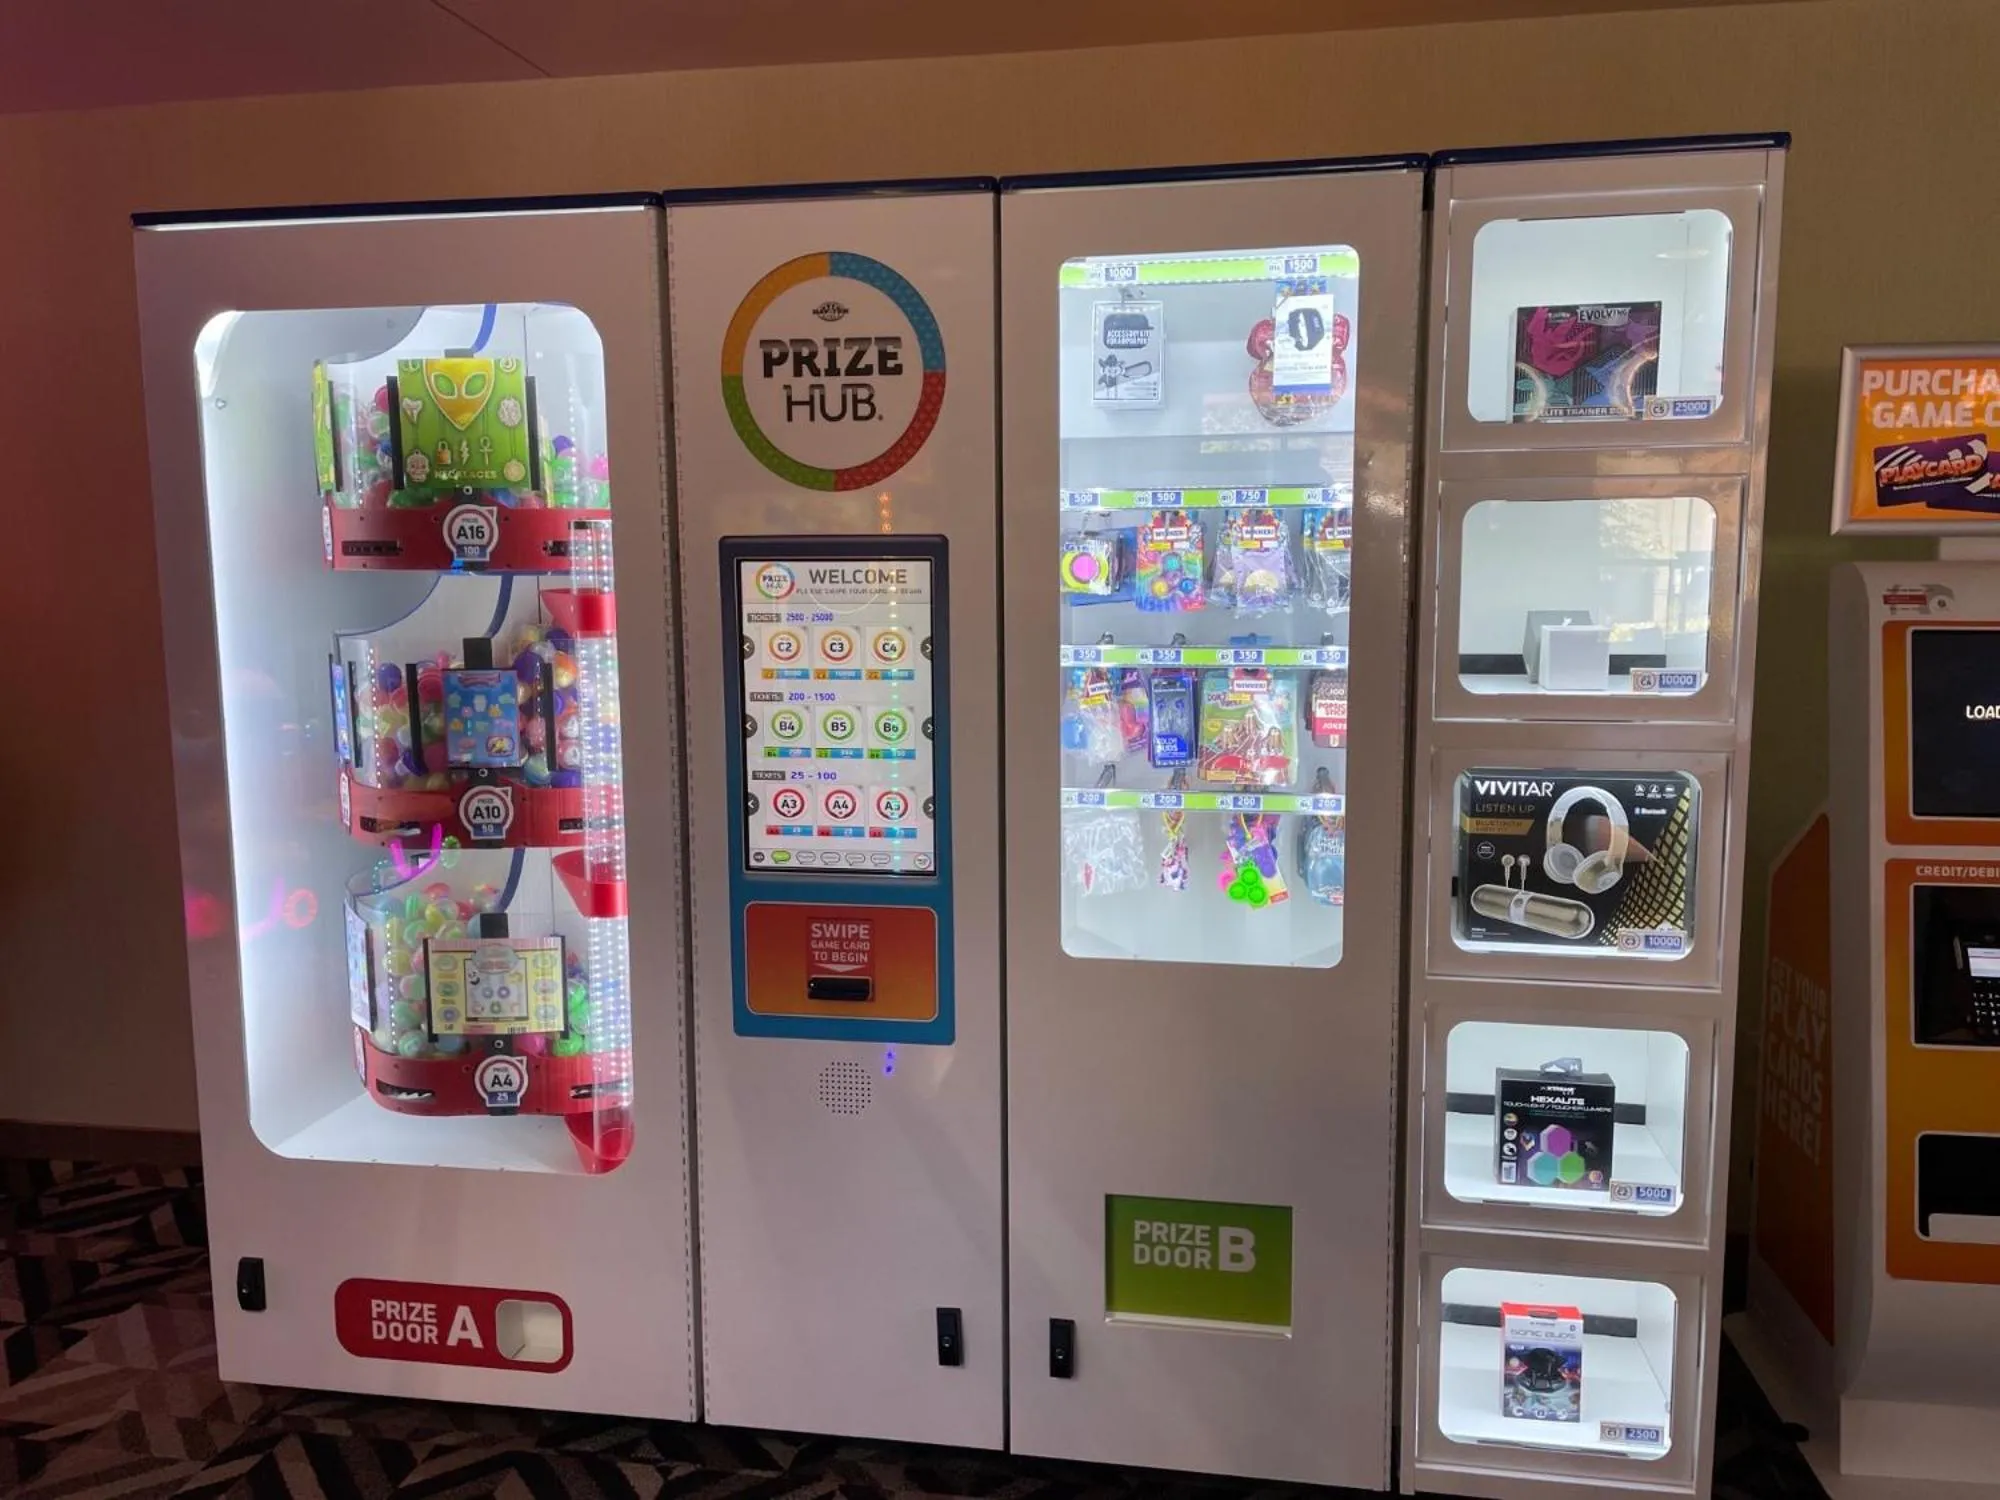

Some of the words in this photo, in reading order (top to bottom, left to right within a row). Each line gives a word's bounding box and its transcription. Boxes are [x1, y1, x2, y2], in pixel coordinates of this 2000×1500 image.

[1289, 260, 1313, 272] 1500
[1109, 268, 1133, 278] 1000
[1579, 309, 1628, 322] EVOLVING
[759, 336, 903, 378] PRIZE
[1862, 369, 2000, 396] PURCHA
[783, 383, 877, 422] HUB
[1675, 402, 1708, 411] 25000
[1540, 408, 1564, 416] ELITE
[1566, 408, 1607, 416] TRAINER
[1653, 406, 1664, 415] C5
[1873, 401, 1974, 428] GAME
[1880, 455, 1984, 484] PLAYCARD
[1074, 493, 1092, 502] 500
[1156, 491, 1176, 501] 500
[1241, 490, 1260, 500] 750
[456, 525, 485, 540] A16
[463, 545, 480, 555] 100
[809, 568, 908, 584] WELCOME
[777, 641, 792, 652] C2
[829, 642, 844, 652] C3
[882, 642, 897, 653] C4
[1078, 650, 1096, 659] 350
[1158, 650, 1176, 659] 350
[1239, 651, 1257, 660] 350
[1322, 652, 1340, 660] 350
[1661, 675, 1693, 685] 10000
[788, 692, 805, 701] 200
[815, 692, 836, 701] 1500
[779, 722, 795, 731] B4
[831, 722, 847, 732] B5
[883, 723, 899, 733] B6
[791, 772, 804, 780] 25
[817, 772, 837, 780] 100
[1474, 780, 1552, 797] VIVITAR
[1082, 794, 1099, 802] 200
[1159, 795, 1177, 804] 200
[1237, 797, 1255, 806] 200
[1317, 799, 1336, 808] 200
[781, 799, 797, 809] A3
[832, 800, 849, 810] A4
[1475, 803, 1516, 814] LISTEN
[1519, 803, 1535, 813] UP
[473, 805, 500, 820] A10
[482, 823, 494, 833] 50
[811, 923, 870, 939] SWIPE
[811, 940, 840, 950] GAME
[843, 941, 870, 951] CARD
[1648, 936, 1680, 947] 10000
[813, 951, 828, 961] TO
[832, 951, 868, 963] BEGIN
[1770, 984, 1826, 1063] PLAY
[1768, 1030, 1823, 1114] CARDS
[491, 1074, 513, 1087] A4
[496, 1092, 508, 1101] 25
[1530, 1095, 1585, 1105] HEXALITE
[1766, 1075, 1822, 1166] HERE!
[1639, 1187, 1667, 1198] 5000
[1134, 1220, 1211, 1246] PRIZE
[1218, 1226, 1256, 1272] B
[1134, 1243, 1211, 1270] DOOR
[371, 1299, 437, 1323] PRIZE
[446, 1305, 484, 1348] A
[372, 1320, 438, 1345] DOOR
[1510, 1328, 1542, 1338] SONIC
[1544, 1330, 1577, 1339] BUDS
[1629, 1428, 1656, 1439] 2500
